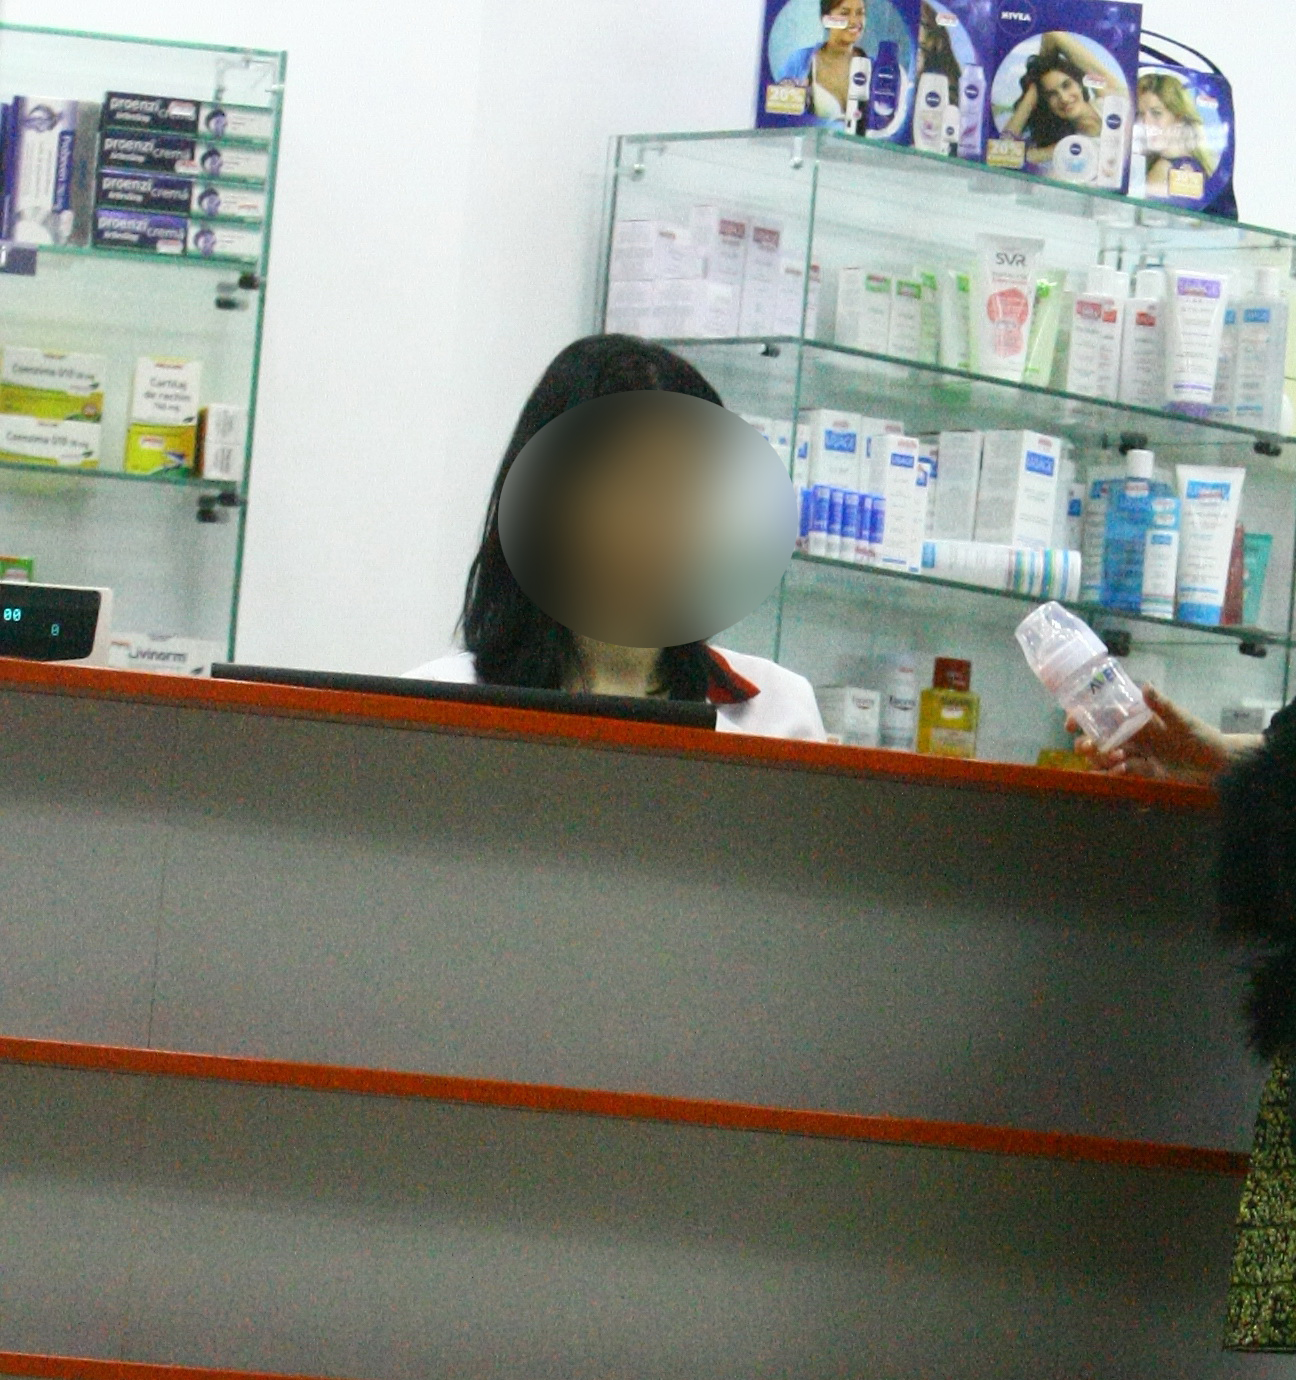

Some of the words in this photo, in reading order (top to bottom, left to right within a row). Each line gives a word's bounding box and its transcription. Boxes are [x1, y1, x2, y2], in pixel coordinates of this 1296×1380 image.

[1001, 11, 1031, 22] NIVEA
[110, 97, 161, 112] proenzi
[104, 138, 155, 153] proenzi
[102, 176, 152, 191] proenzi
[97, 216, 148, 232] proenzi
[996, 252, 1026, 266] SVR
